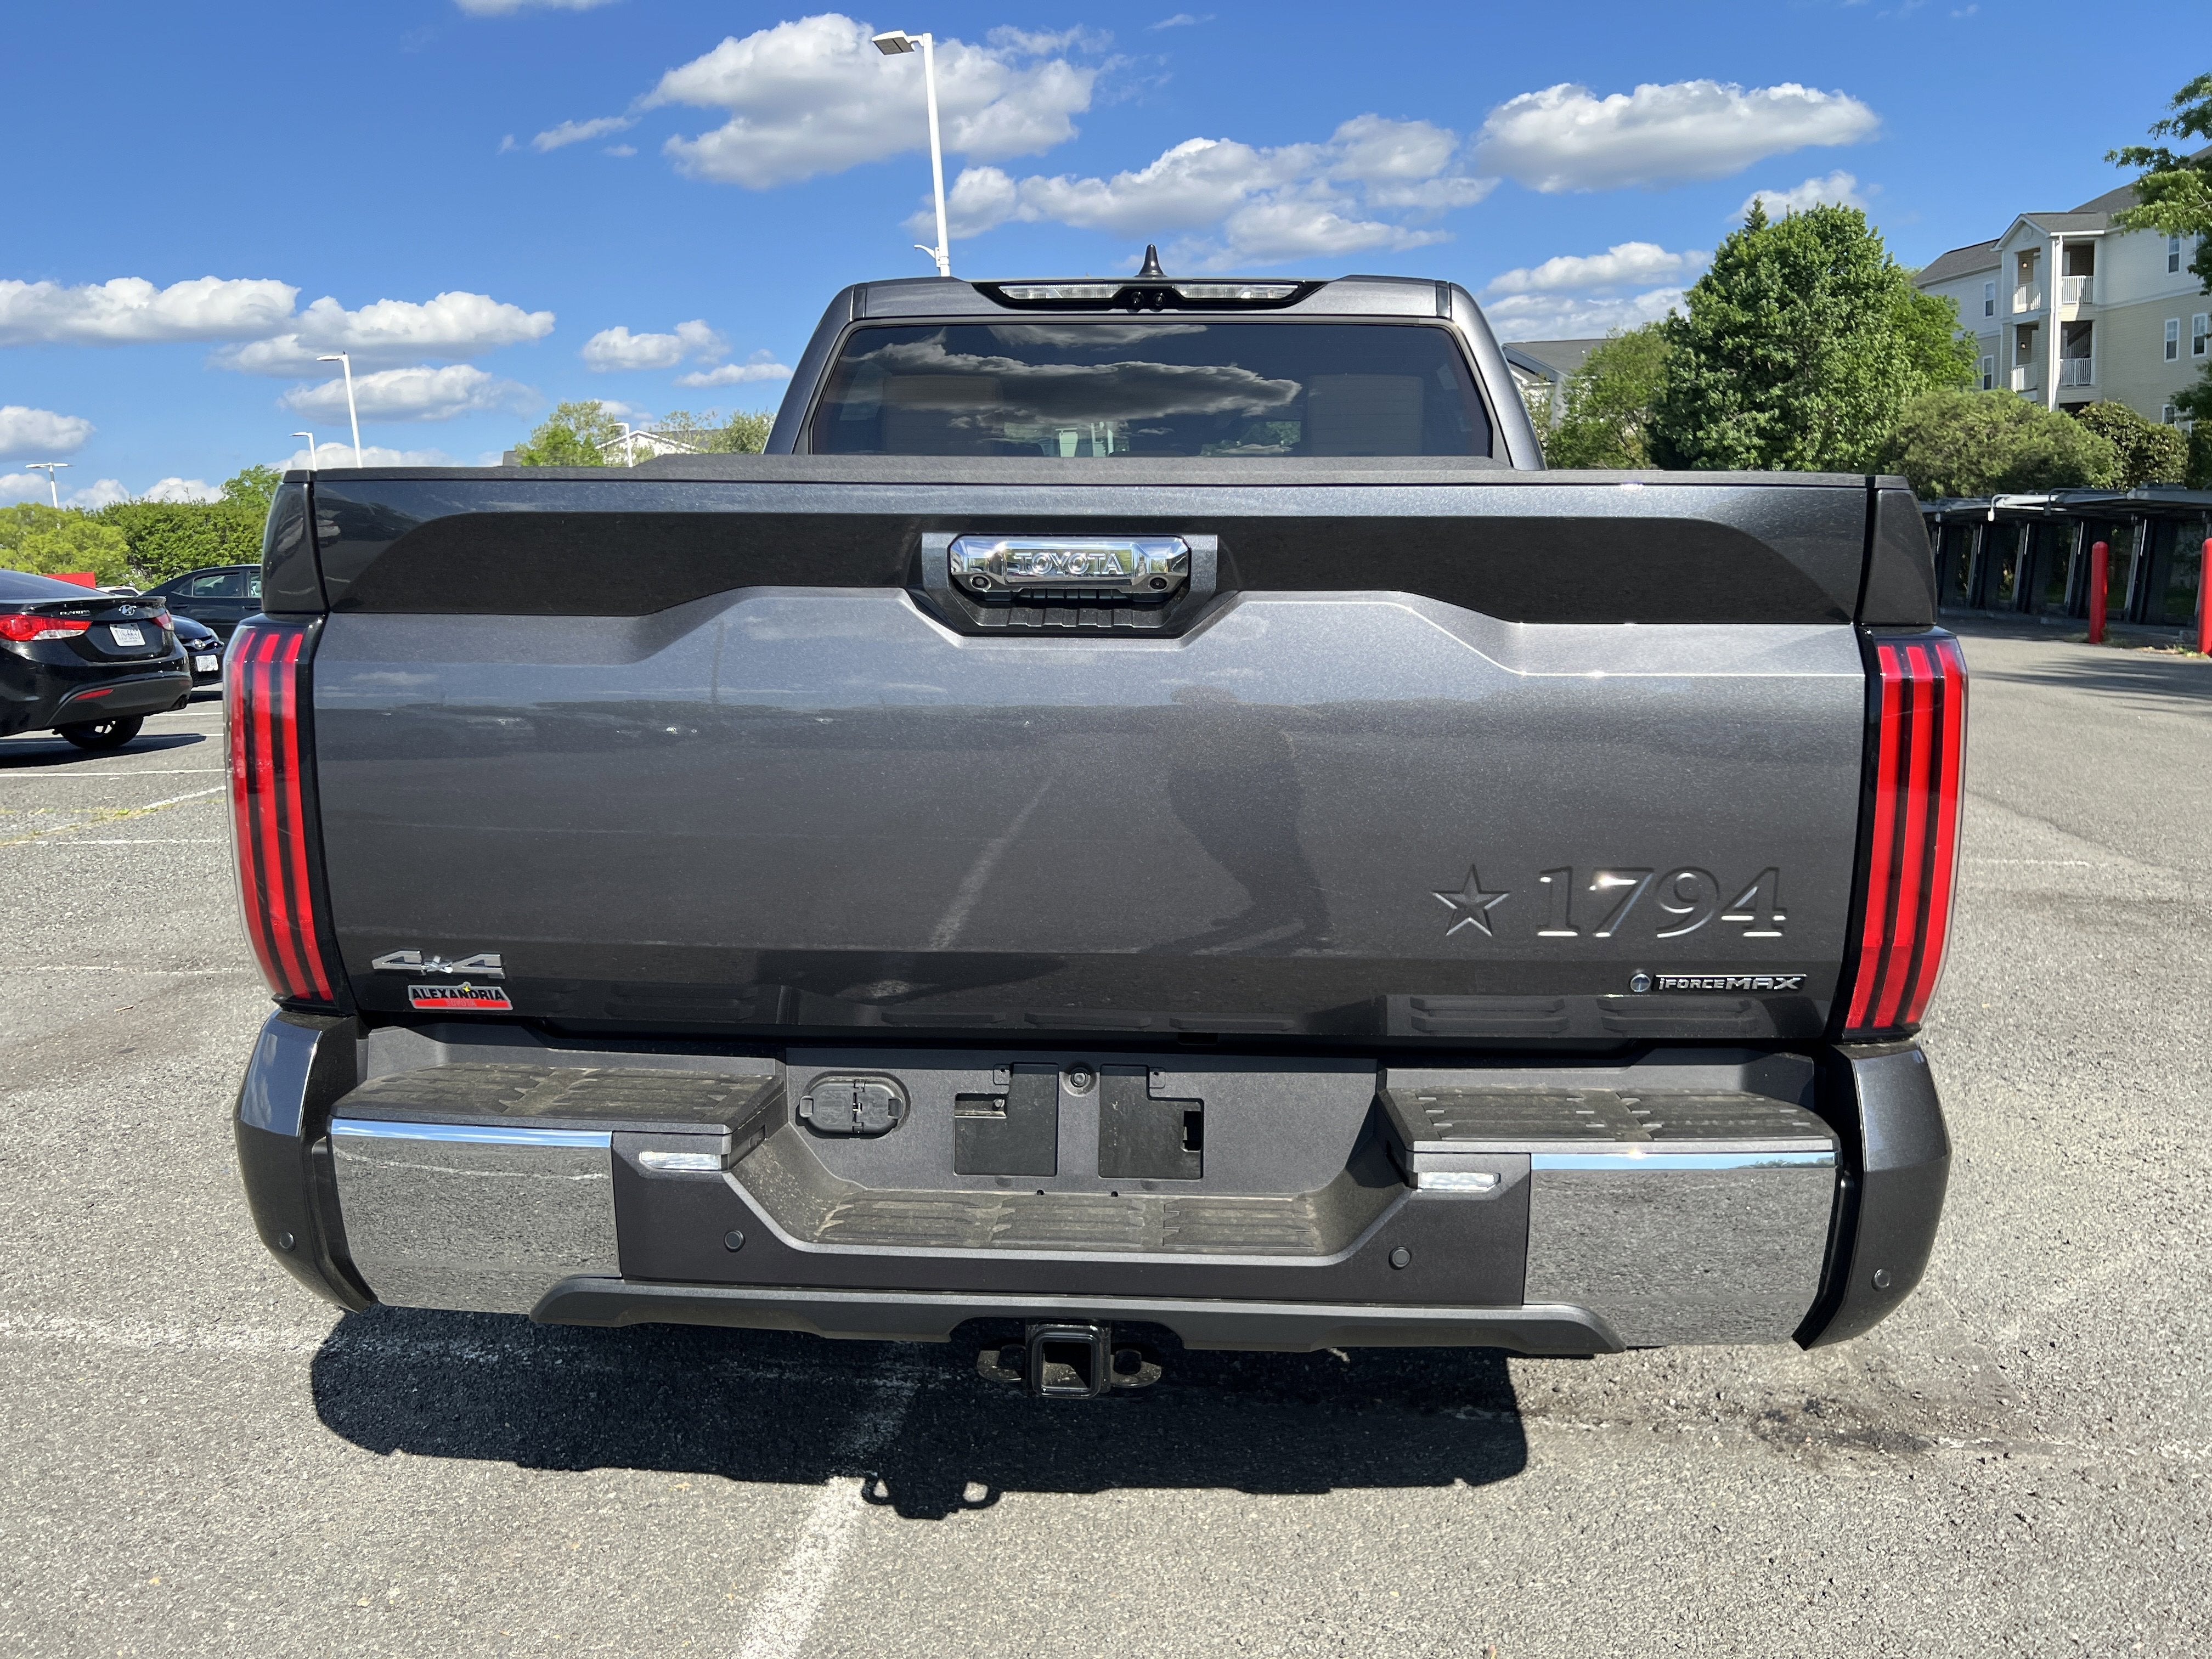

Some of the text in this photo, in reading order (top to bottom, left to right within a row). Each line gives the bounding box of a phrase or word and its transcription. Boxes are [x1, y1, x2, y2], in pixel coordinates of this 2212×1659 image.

[1013, 551, 1125, 575] TOYOTA
[1537, 865, 1787, 938] 1794
[412, 988, 505, 1001] ALEXANDRIA
